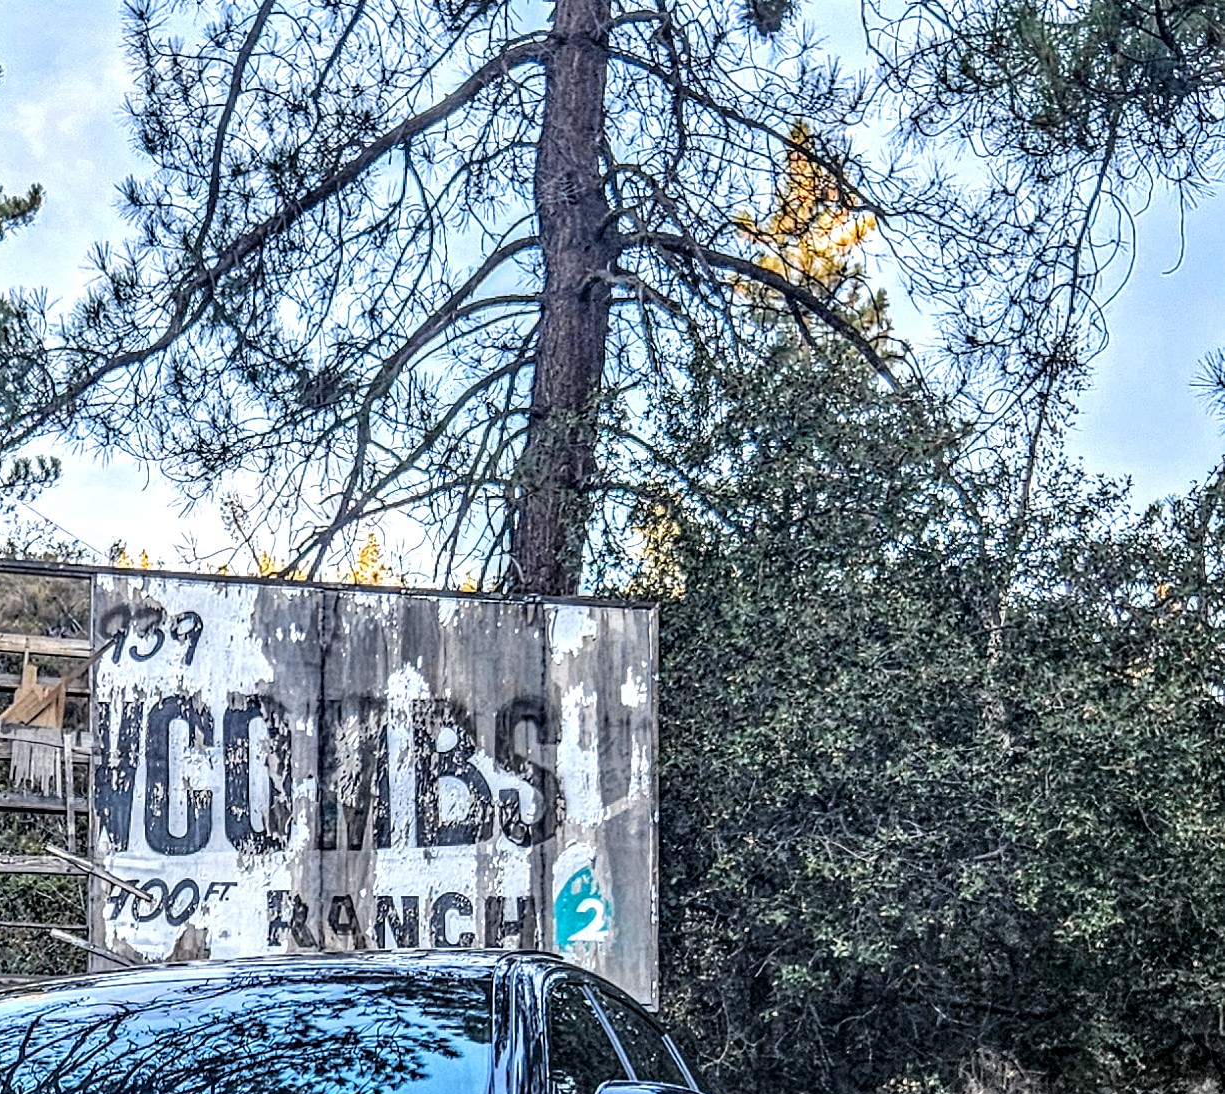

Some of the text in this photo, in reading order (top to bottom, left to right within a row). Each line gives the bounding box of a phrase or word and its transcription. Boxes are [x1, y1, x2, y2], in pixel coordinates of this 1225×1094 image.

[99, 602, 204, 666] 939
[266, 889, 537, 949] RANCH
[568, 898, 609, 941] 2
